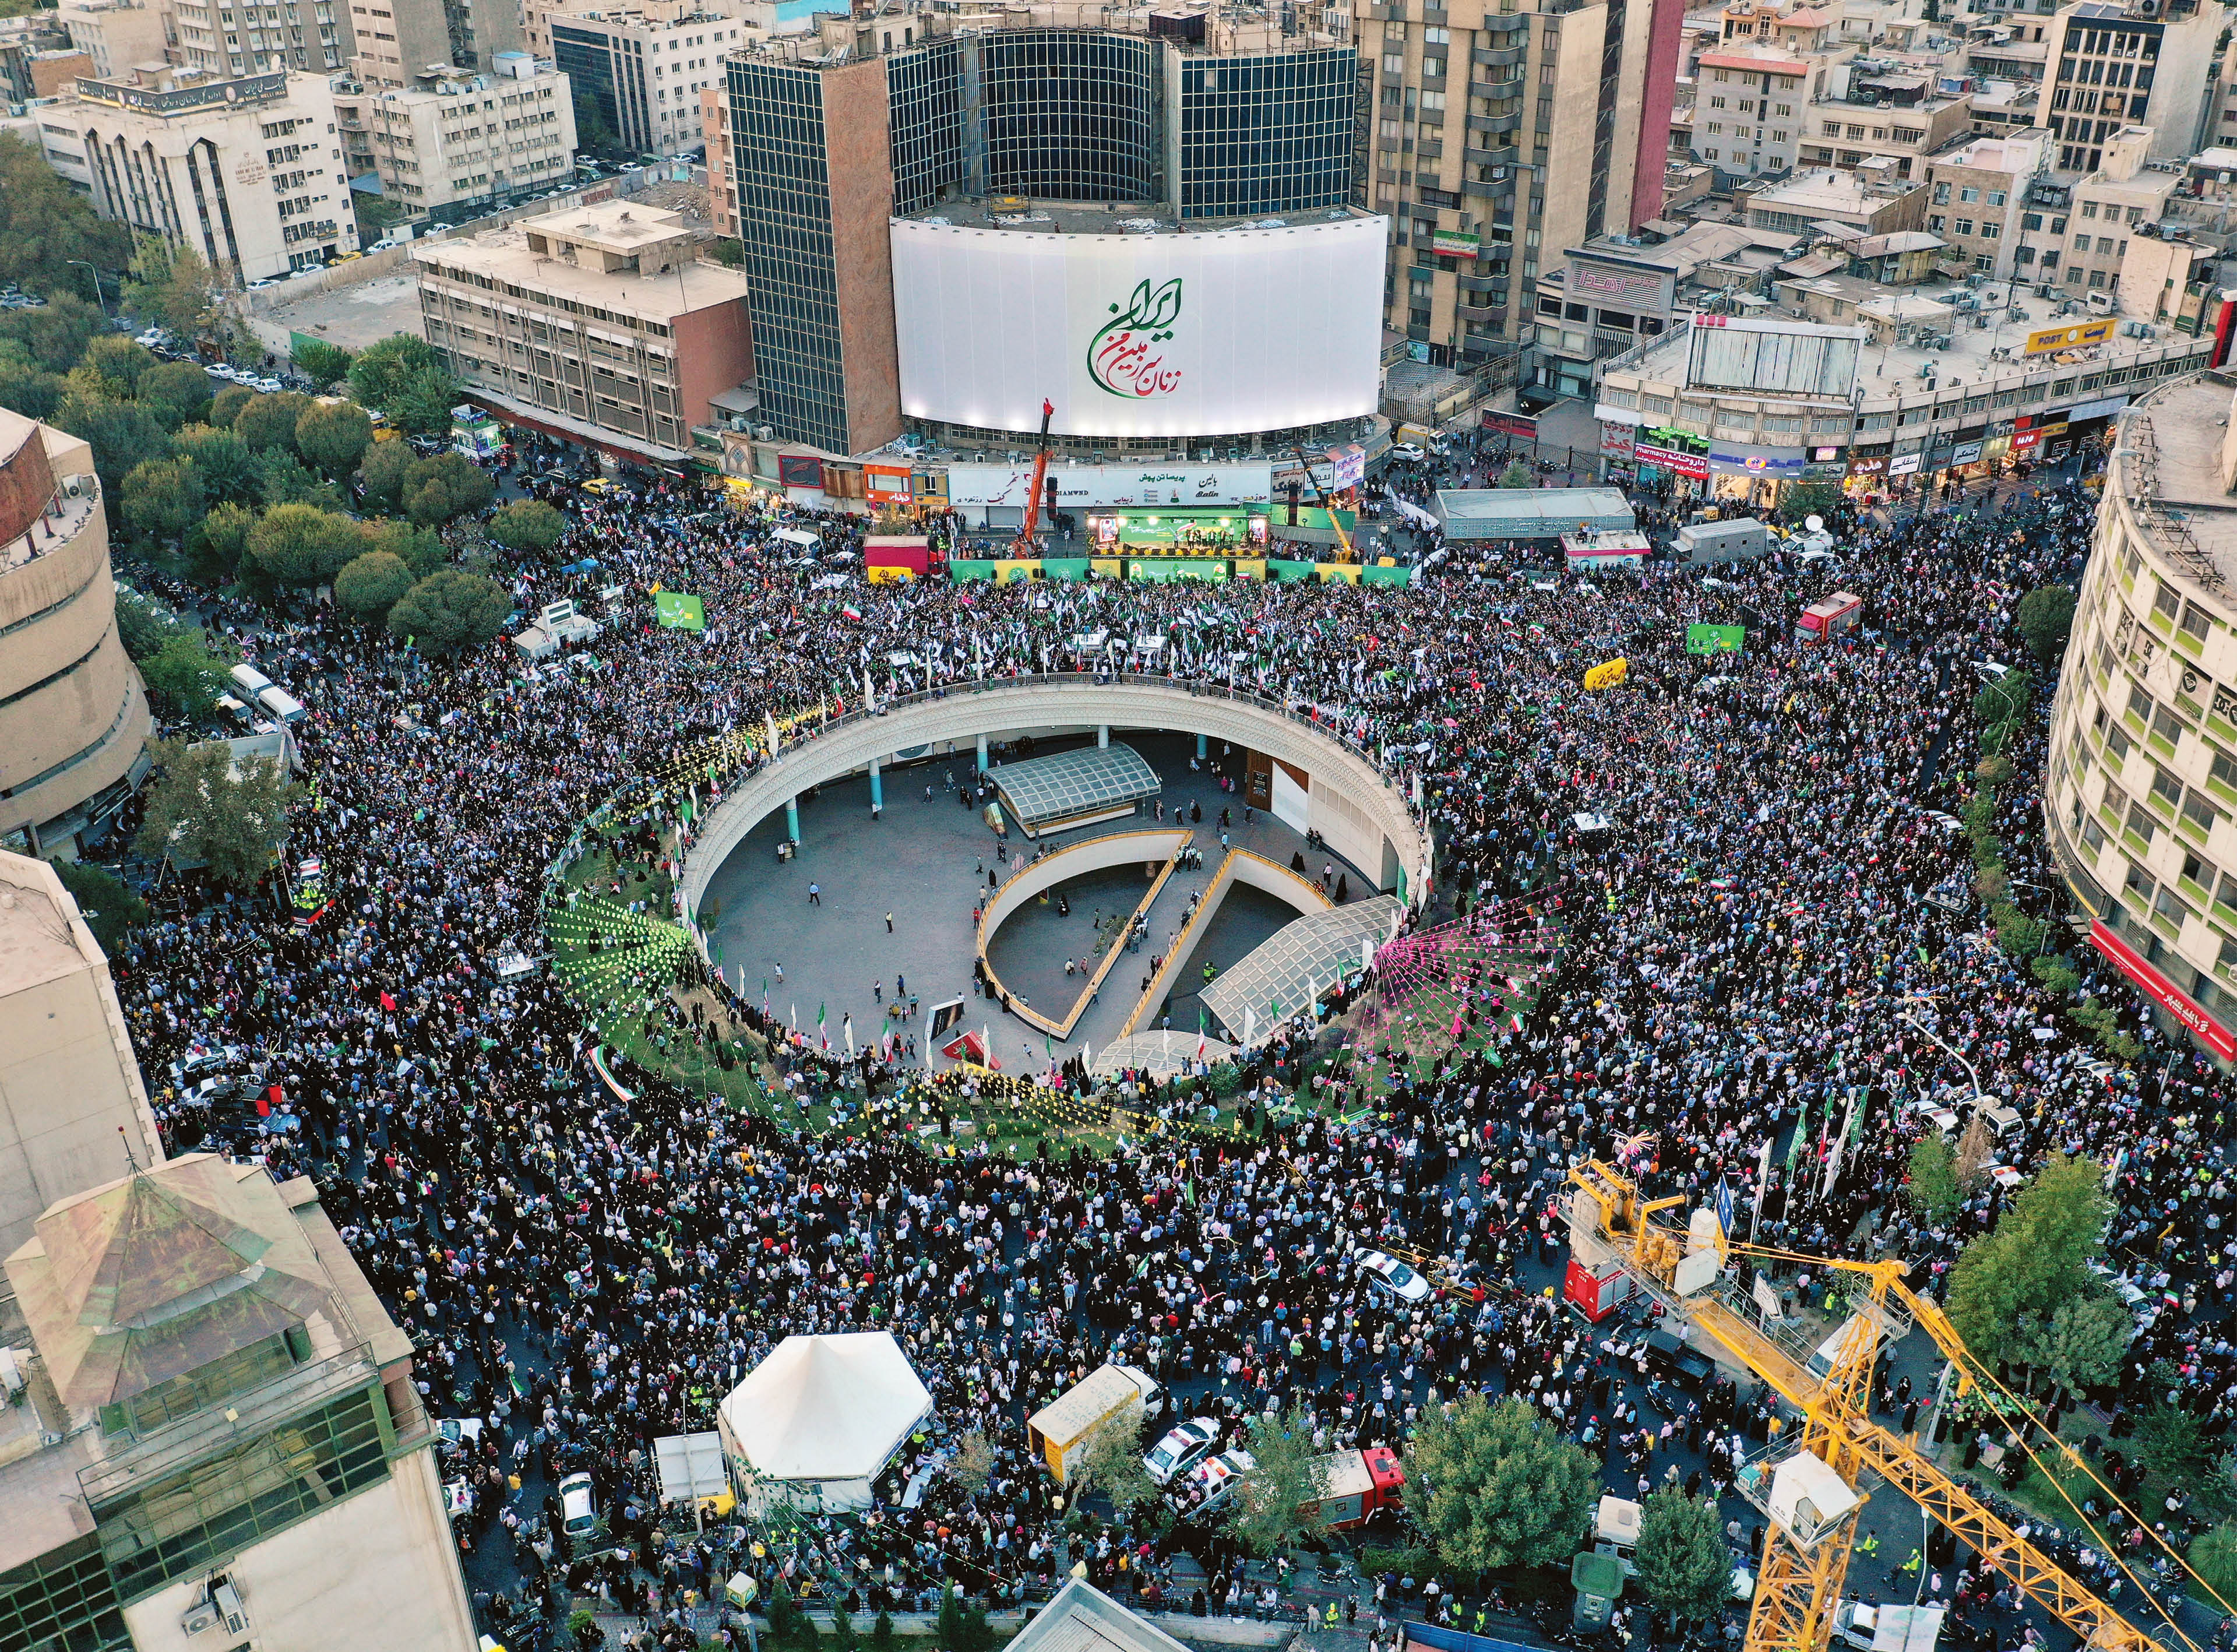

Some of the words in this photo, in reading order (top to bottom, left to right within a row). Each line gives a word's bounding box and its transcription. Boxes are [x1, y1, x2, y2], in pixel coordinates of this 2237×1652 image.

[244, 83, 258, 95] ایران
[265, 73, 284, 91] بانک
[1087, 278, 1182, 400] ایران
[2037, 333, 2063, 346] POST
[1095, 332, 1130, 379] من
[1106, 340, 1163, 392] سرزمین
[1135, 369, 1182, 397] زنان
[1635, 446, 1667, 459] Pharmacy
[1667, 453, 1706, 467] داروخانه
[1139, 473, 1156, 483] پوش
[1156, 473, 1165, 481] تن
[1166, 472, 1186, 482] پریسا
[1198, 473, 1218, 488] بالین
[2183, 1008, 2200, 1028] بانک
